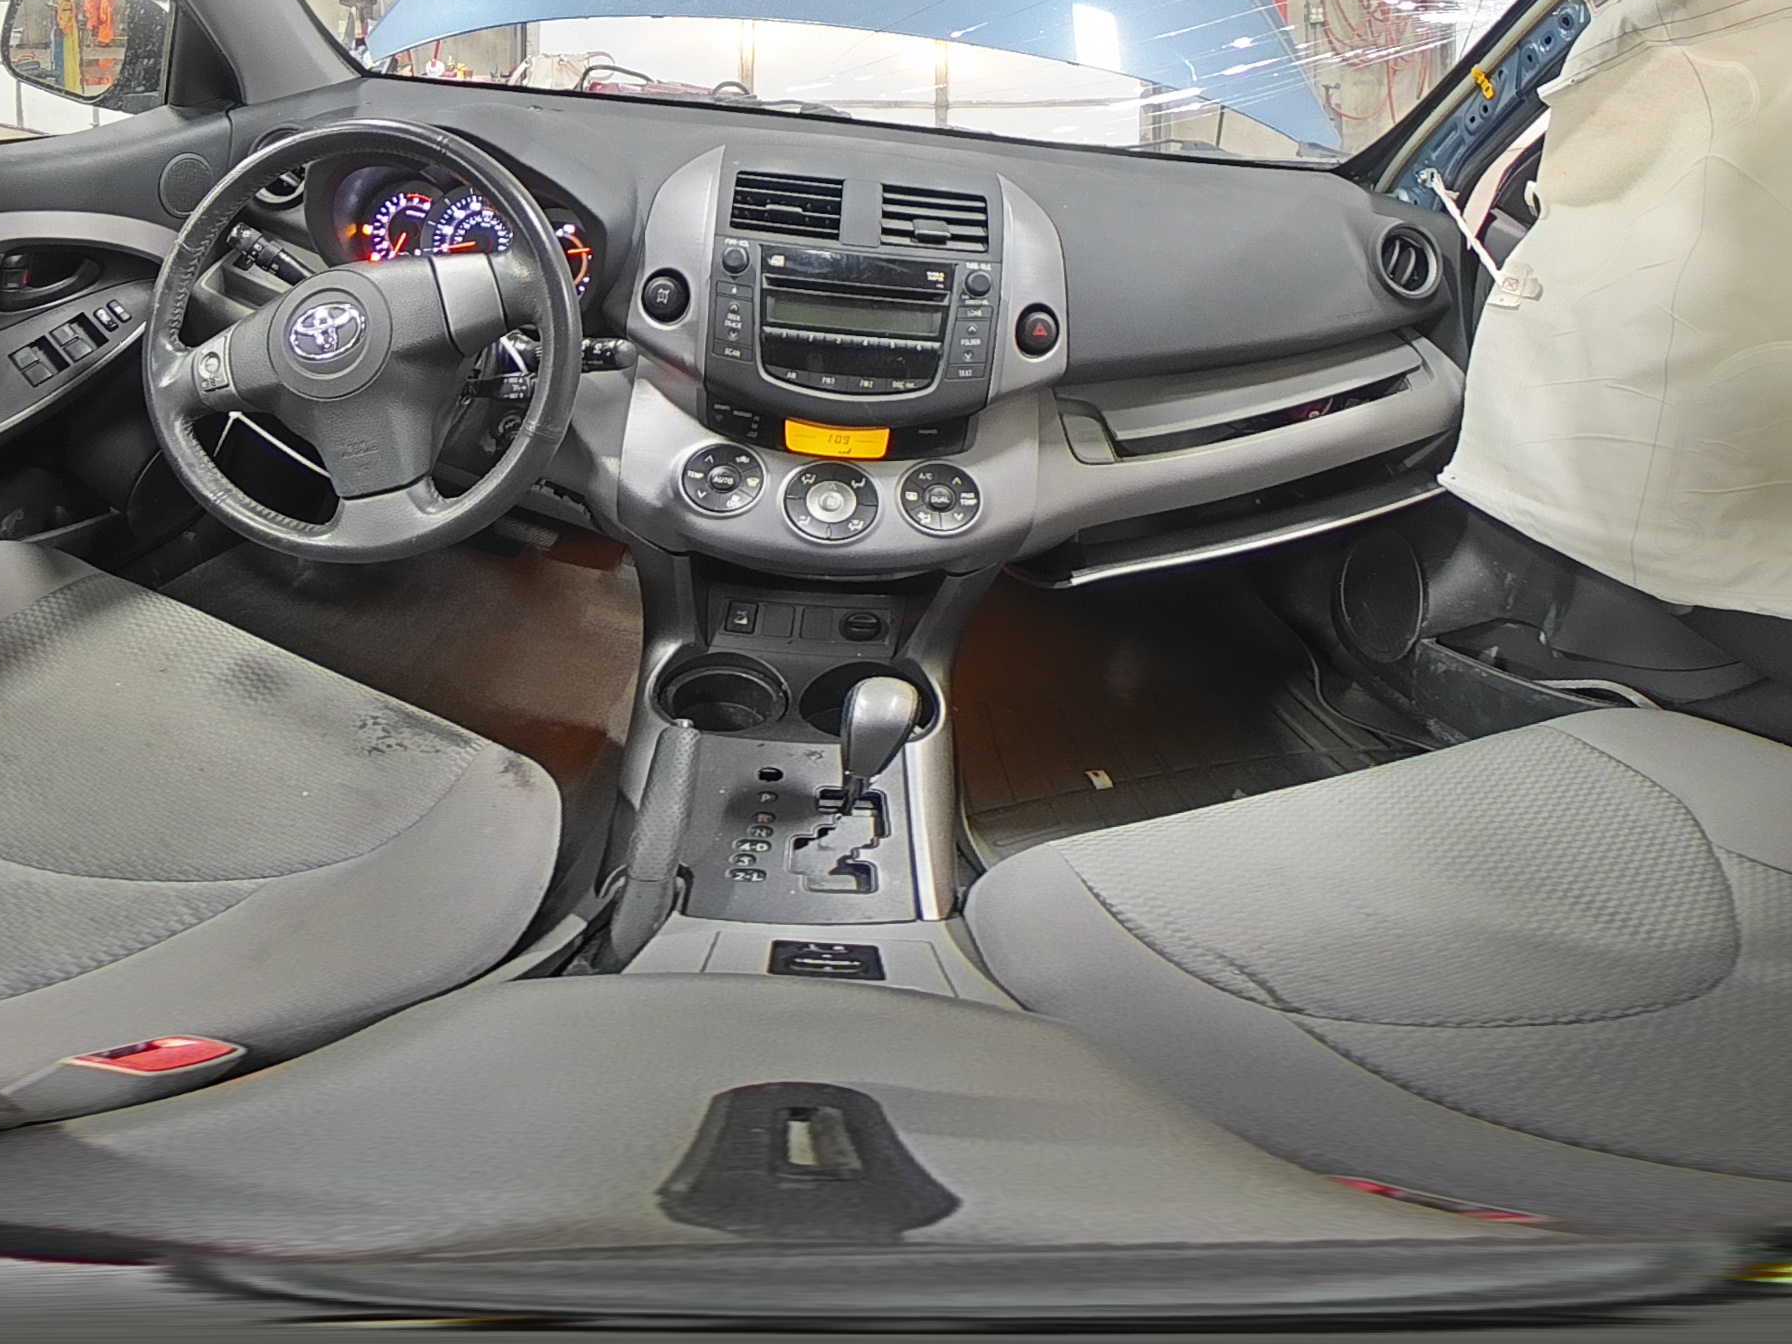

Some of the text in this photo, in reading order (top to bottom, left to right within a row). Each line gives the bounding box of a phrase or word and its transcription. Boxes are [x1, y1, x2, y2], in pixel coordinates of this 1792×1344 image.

[687, 470, 705, 479] TEMP
[918, 471, 933, 481] A/C
[712, 475, 734, 485] AUTO
[930, 495, 950, 504] DUAL
[761, 793, 771, 803] P
[754, 829, 768, 838] N
[733, 872, 764, 882] 2-L
